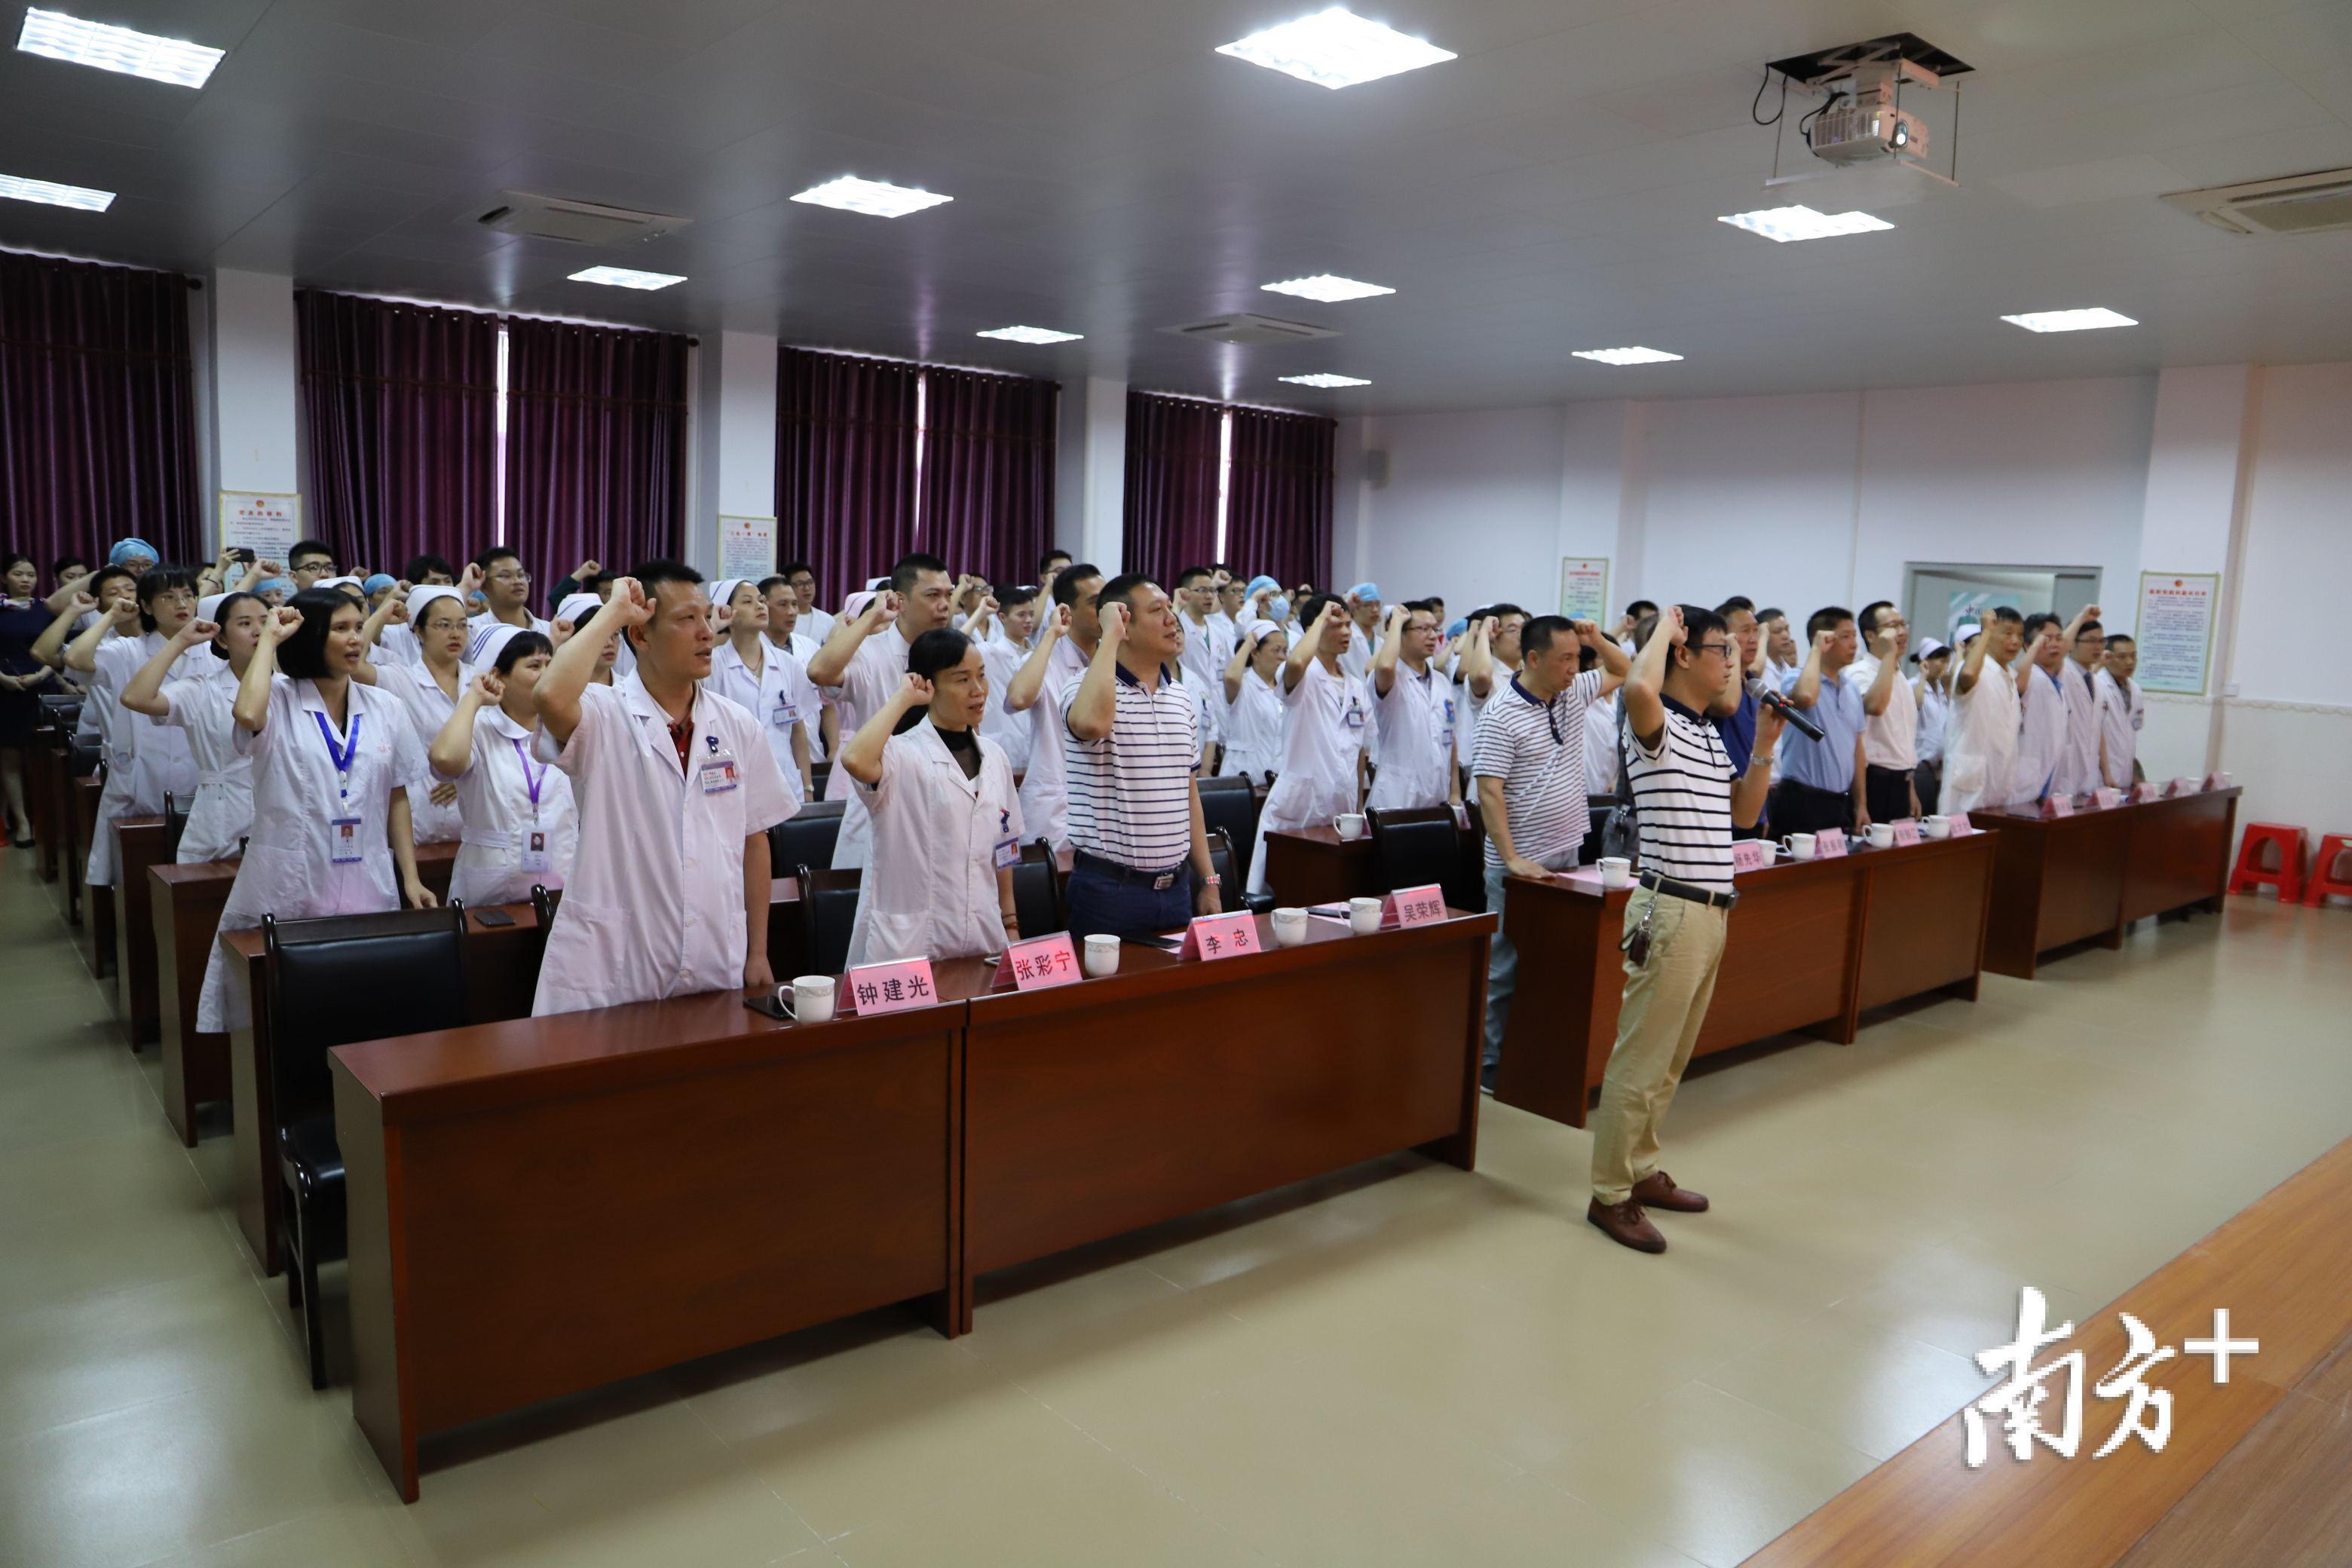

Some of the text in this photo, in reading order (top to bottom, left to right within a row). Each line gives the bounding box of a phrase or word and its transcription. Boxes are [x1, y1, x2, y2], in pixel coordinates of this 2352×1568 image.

[1404, 900, 1441, 922] 吴荣辉
[1206, 929, 1248, 954] 李忠
[1015, 951, 1070, 980] 张彩宁
[857, 975, 929, 1005] 钟建光
